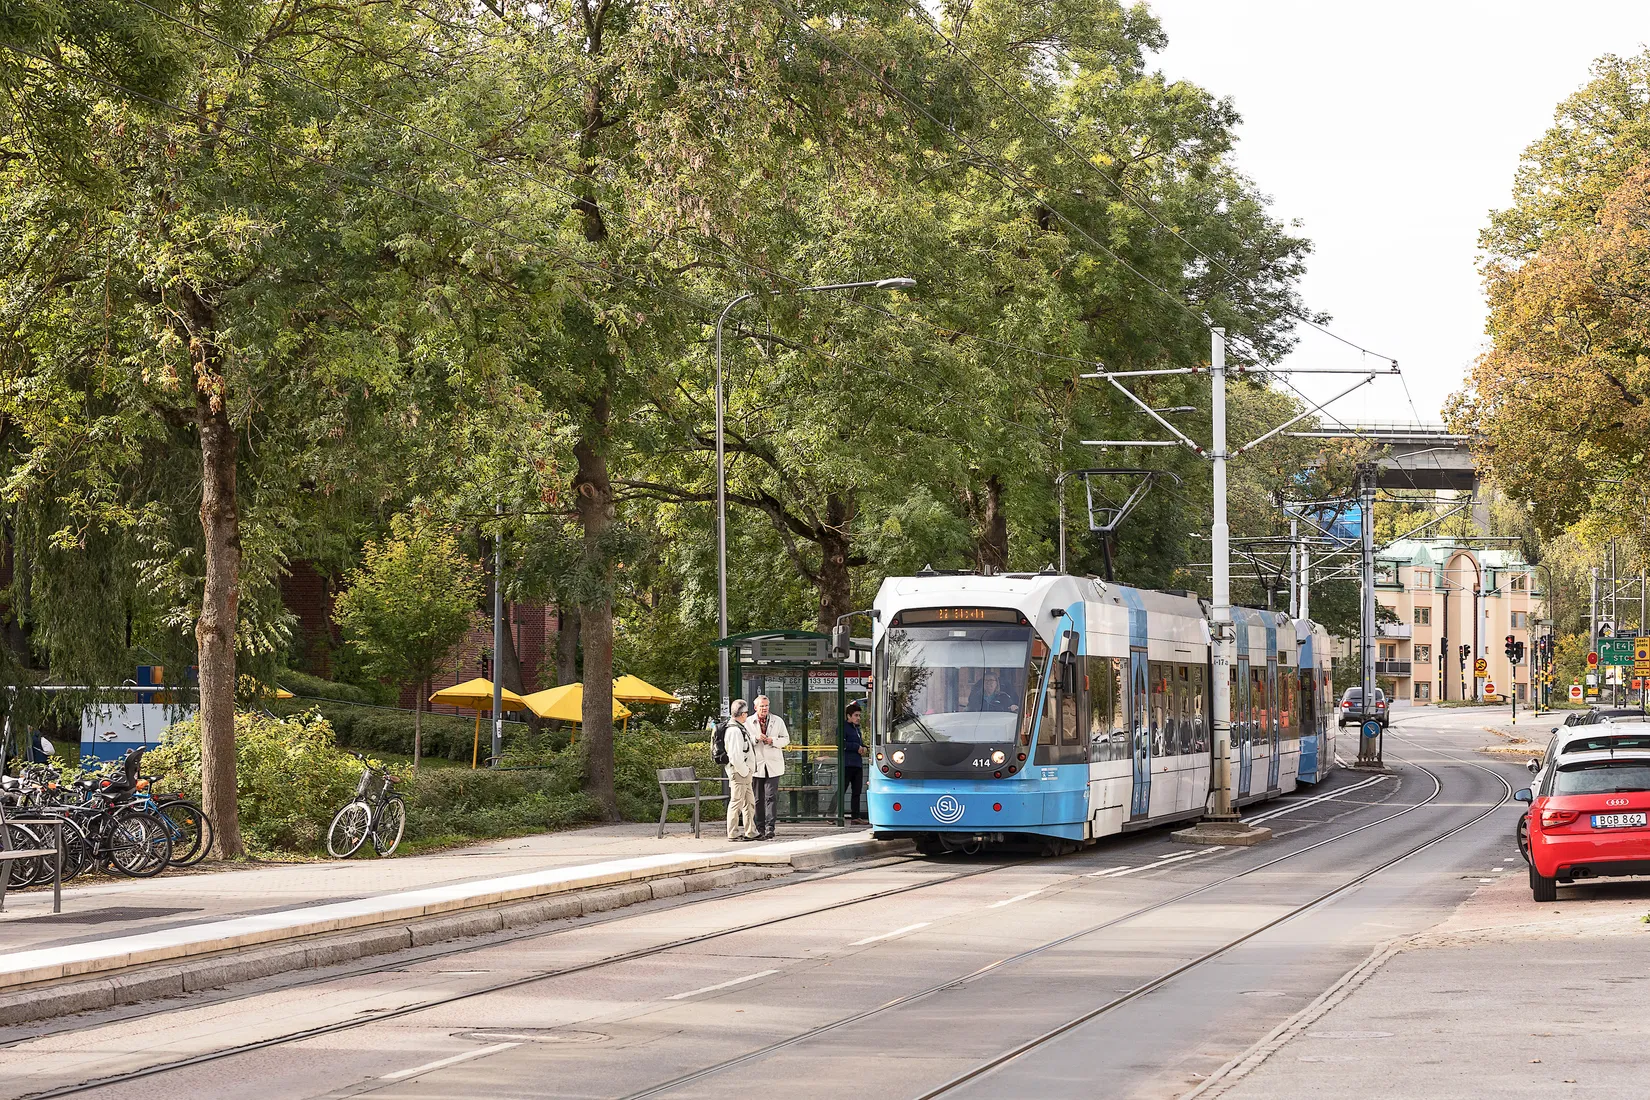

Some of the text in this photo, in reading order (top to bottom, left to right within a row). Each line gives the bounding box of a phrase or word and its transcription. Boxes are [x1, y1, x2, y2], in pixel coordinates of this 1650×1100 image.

[972, 758, 991, 767] 414
[940, 801, 955, 812] SL
[1600, 814, 1642, 824] BGB 862
